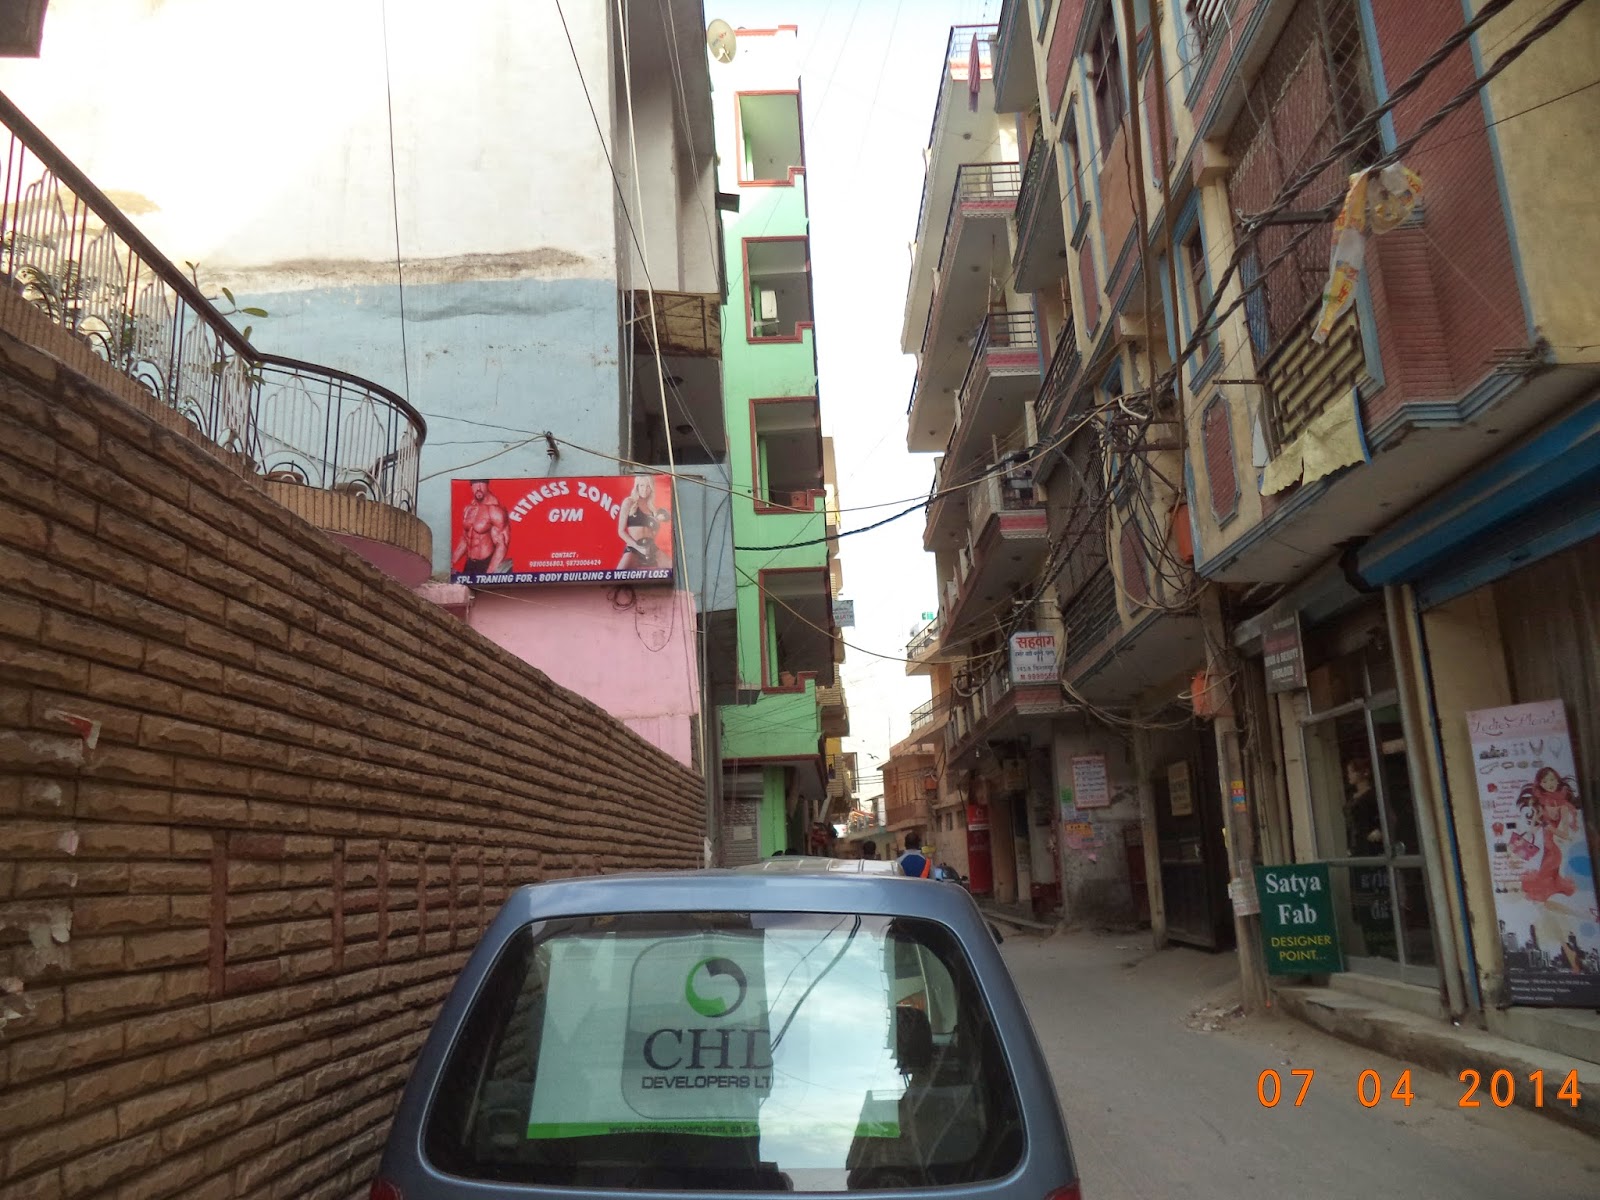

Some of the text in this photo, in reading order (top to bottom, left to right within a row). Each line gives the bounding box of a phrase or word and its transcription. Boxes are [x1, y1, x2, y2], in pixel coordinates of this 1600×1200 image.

[508, 481, 621, 522] FITNESS ZONE
[548, 508, 584, 523] GYM
[456, 575, 473, 584] SPL.
[476, 574, 514, 584] TRANING
[539, 573, 562, 582] BODY
[563, 572, 604, 581] BUILDING
[605, 571, 612, 580] &
[613, 570, 647, 580] WEIGHT
[648, 569, 669, 578] LOSS
[1265, 873, 1322, 898] Satya
[1277, 903, 1318, 925] Fab
[1270, 935, 1332, 948] DESIGNER
[641, 1075, 777, 1089] DEVELOPERS LT
